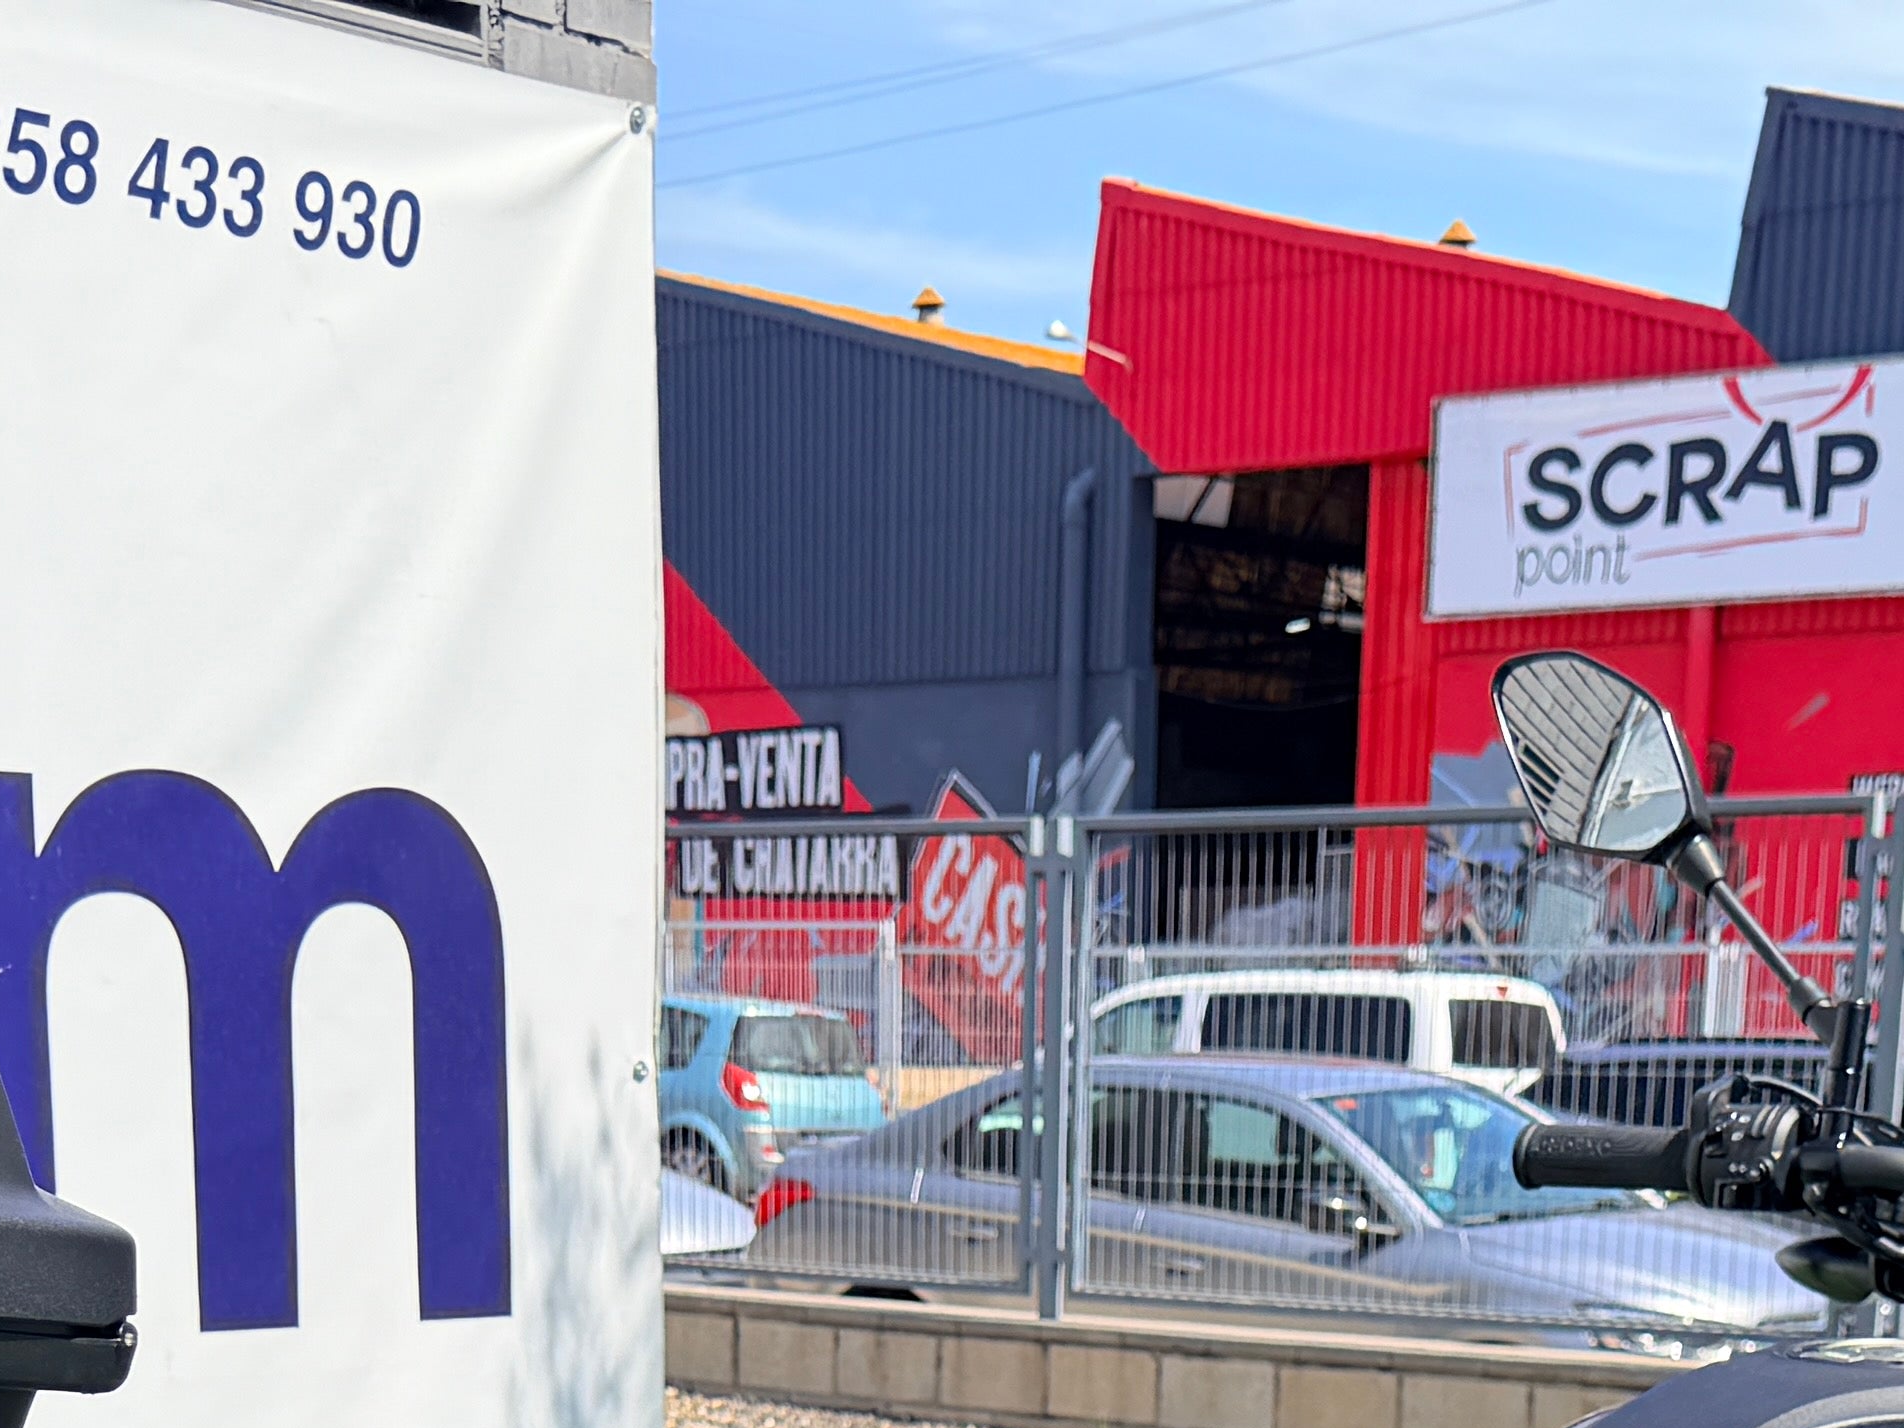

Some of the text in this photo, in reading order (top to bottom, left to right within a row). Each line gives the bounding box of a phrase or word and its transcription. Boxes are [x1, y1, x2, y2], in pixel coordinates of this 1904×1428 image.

[127, 138, 265, 238] 433
[293, 171, 421, 268] 930
[1522, 418, 1879, 532] SCRAP
[1514, 531, 1631, 598] point
